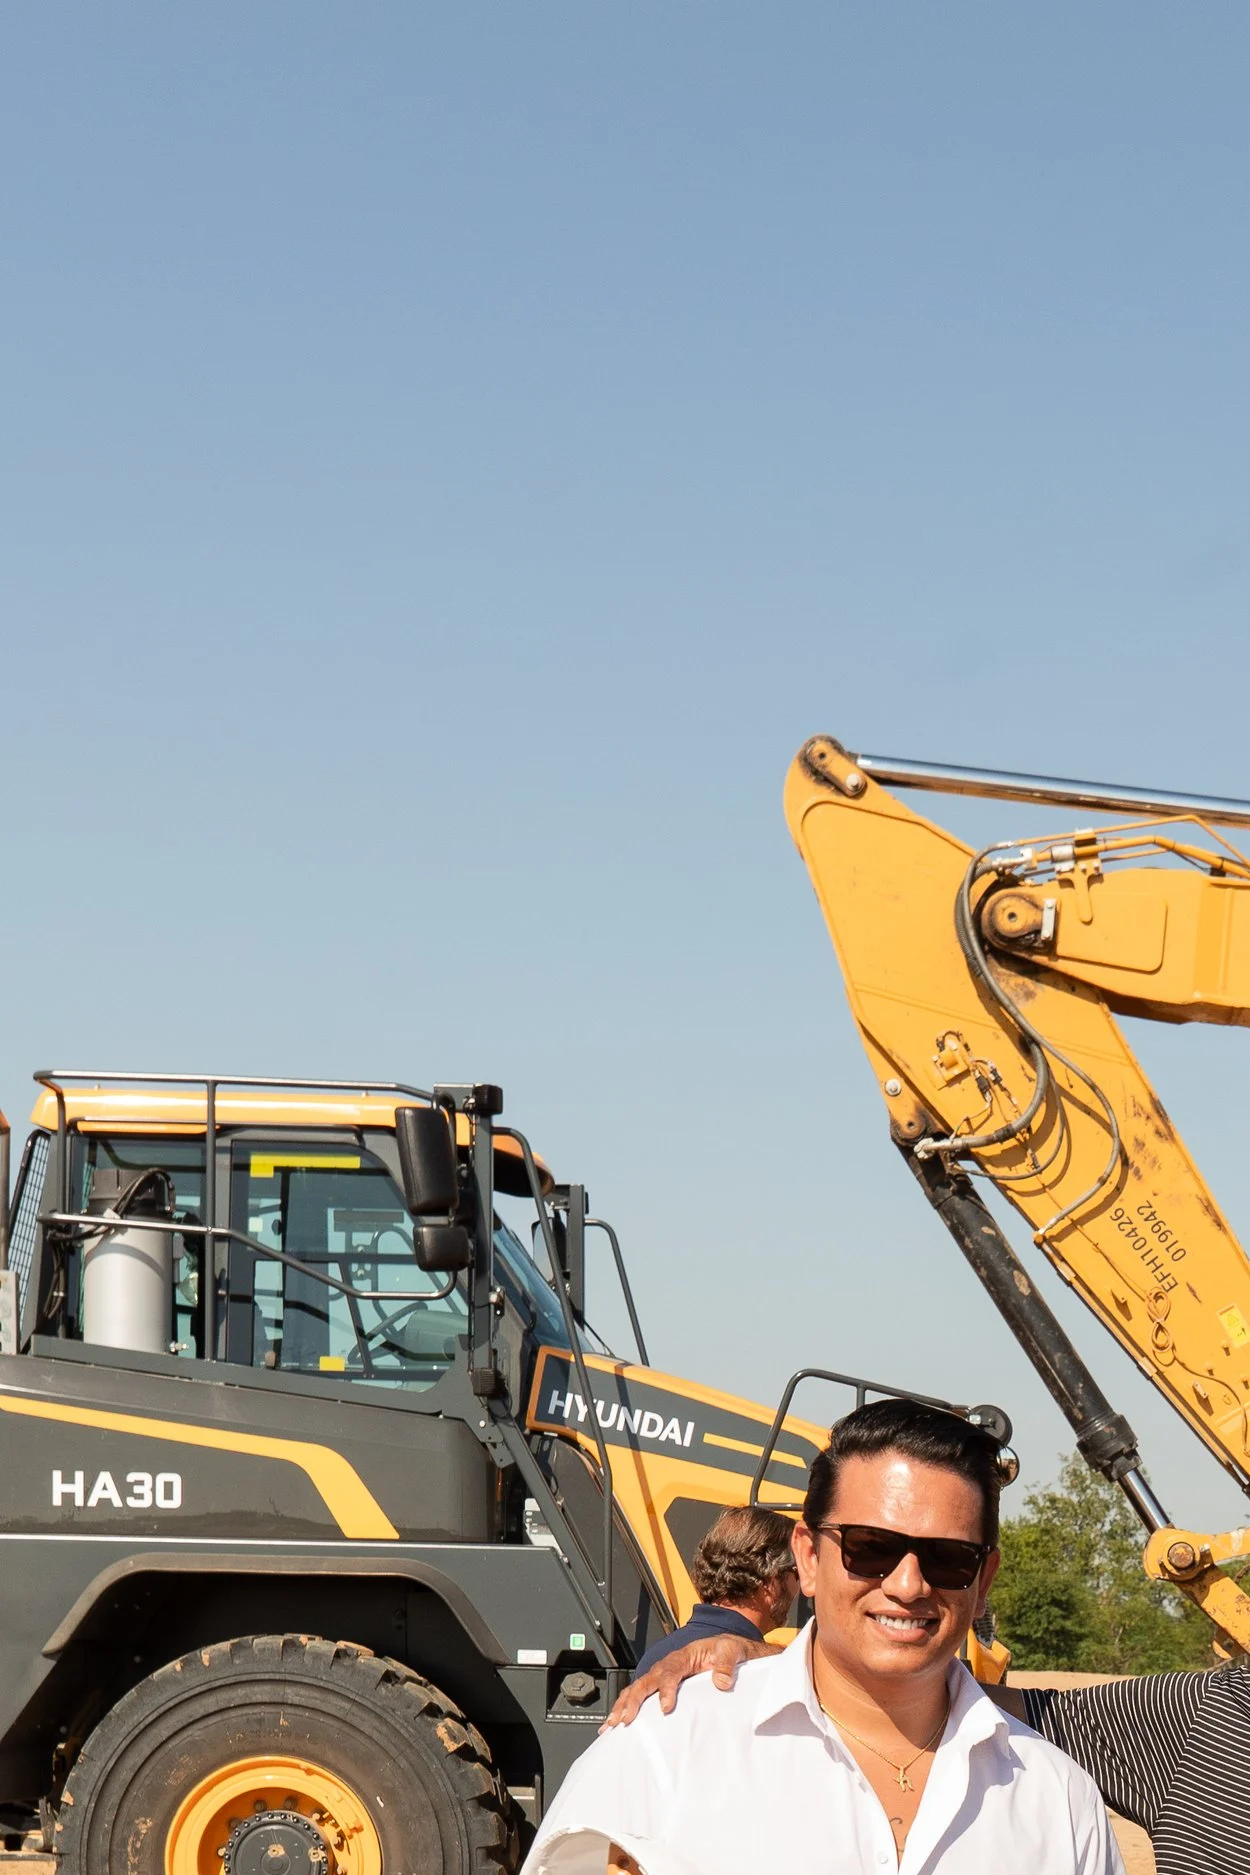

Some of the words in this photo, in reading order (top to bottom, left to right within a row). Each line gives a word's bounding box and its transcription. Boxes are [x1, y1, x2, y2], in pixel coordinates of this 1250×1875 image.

[1110, 1208, 1178, 1293] EFH10426
[1137, 1200, 1186, 1262] 019942
[548, 1390, 695, 1447] HYUNDAI
[52, 1470, 182, 1508] HA30
